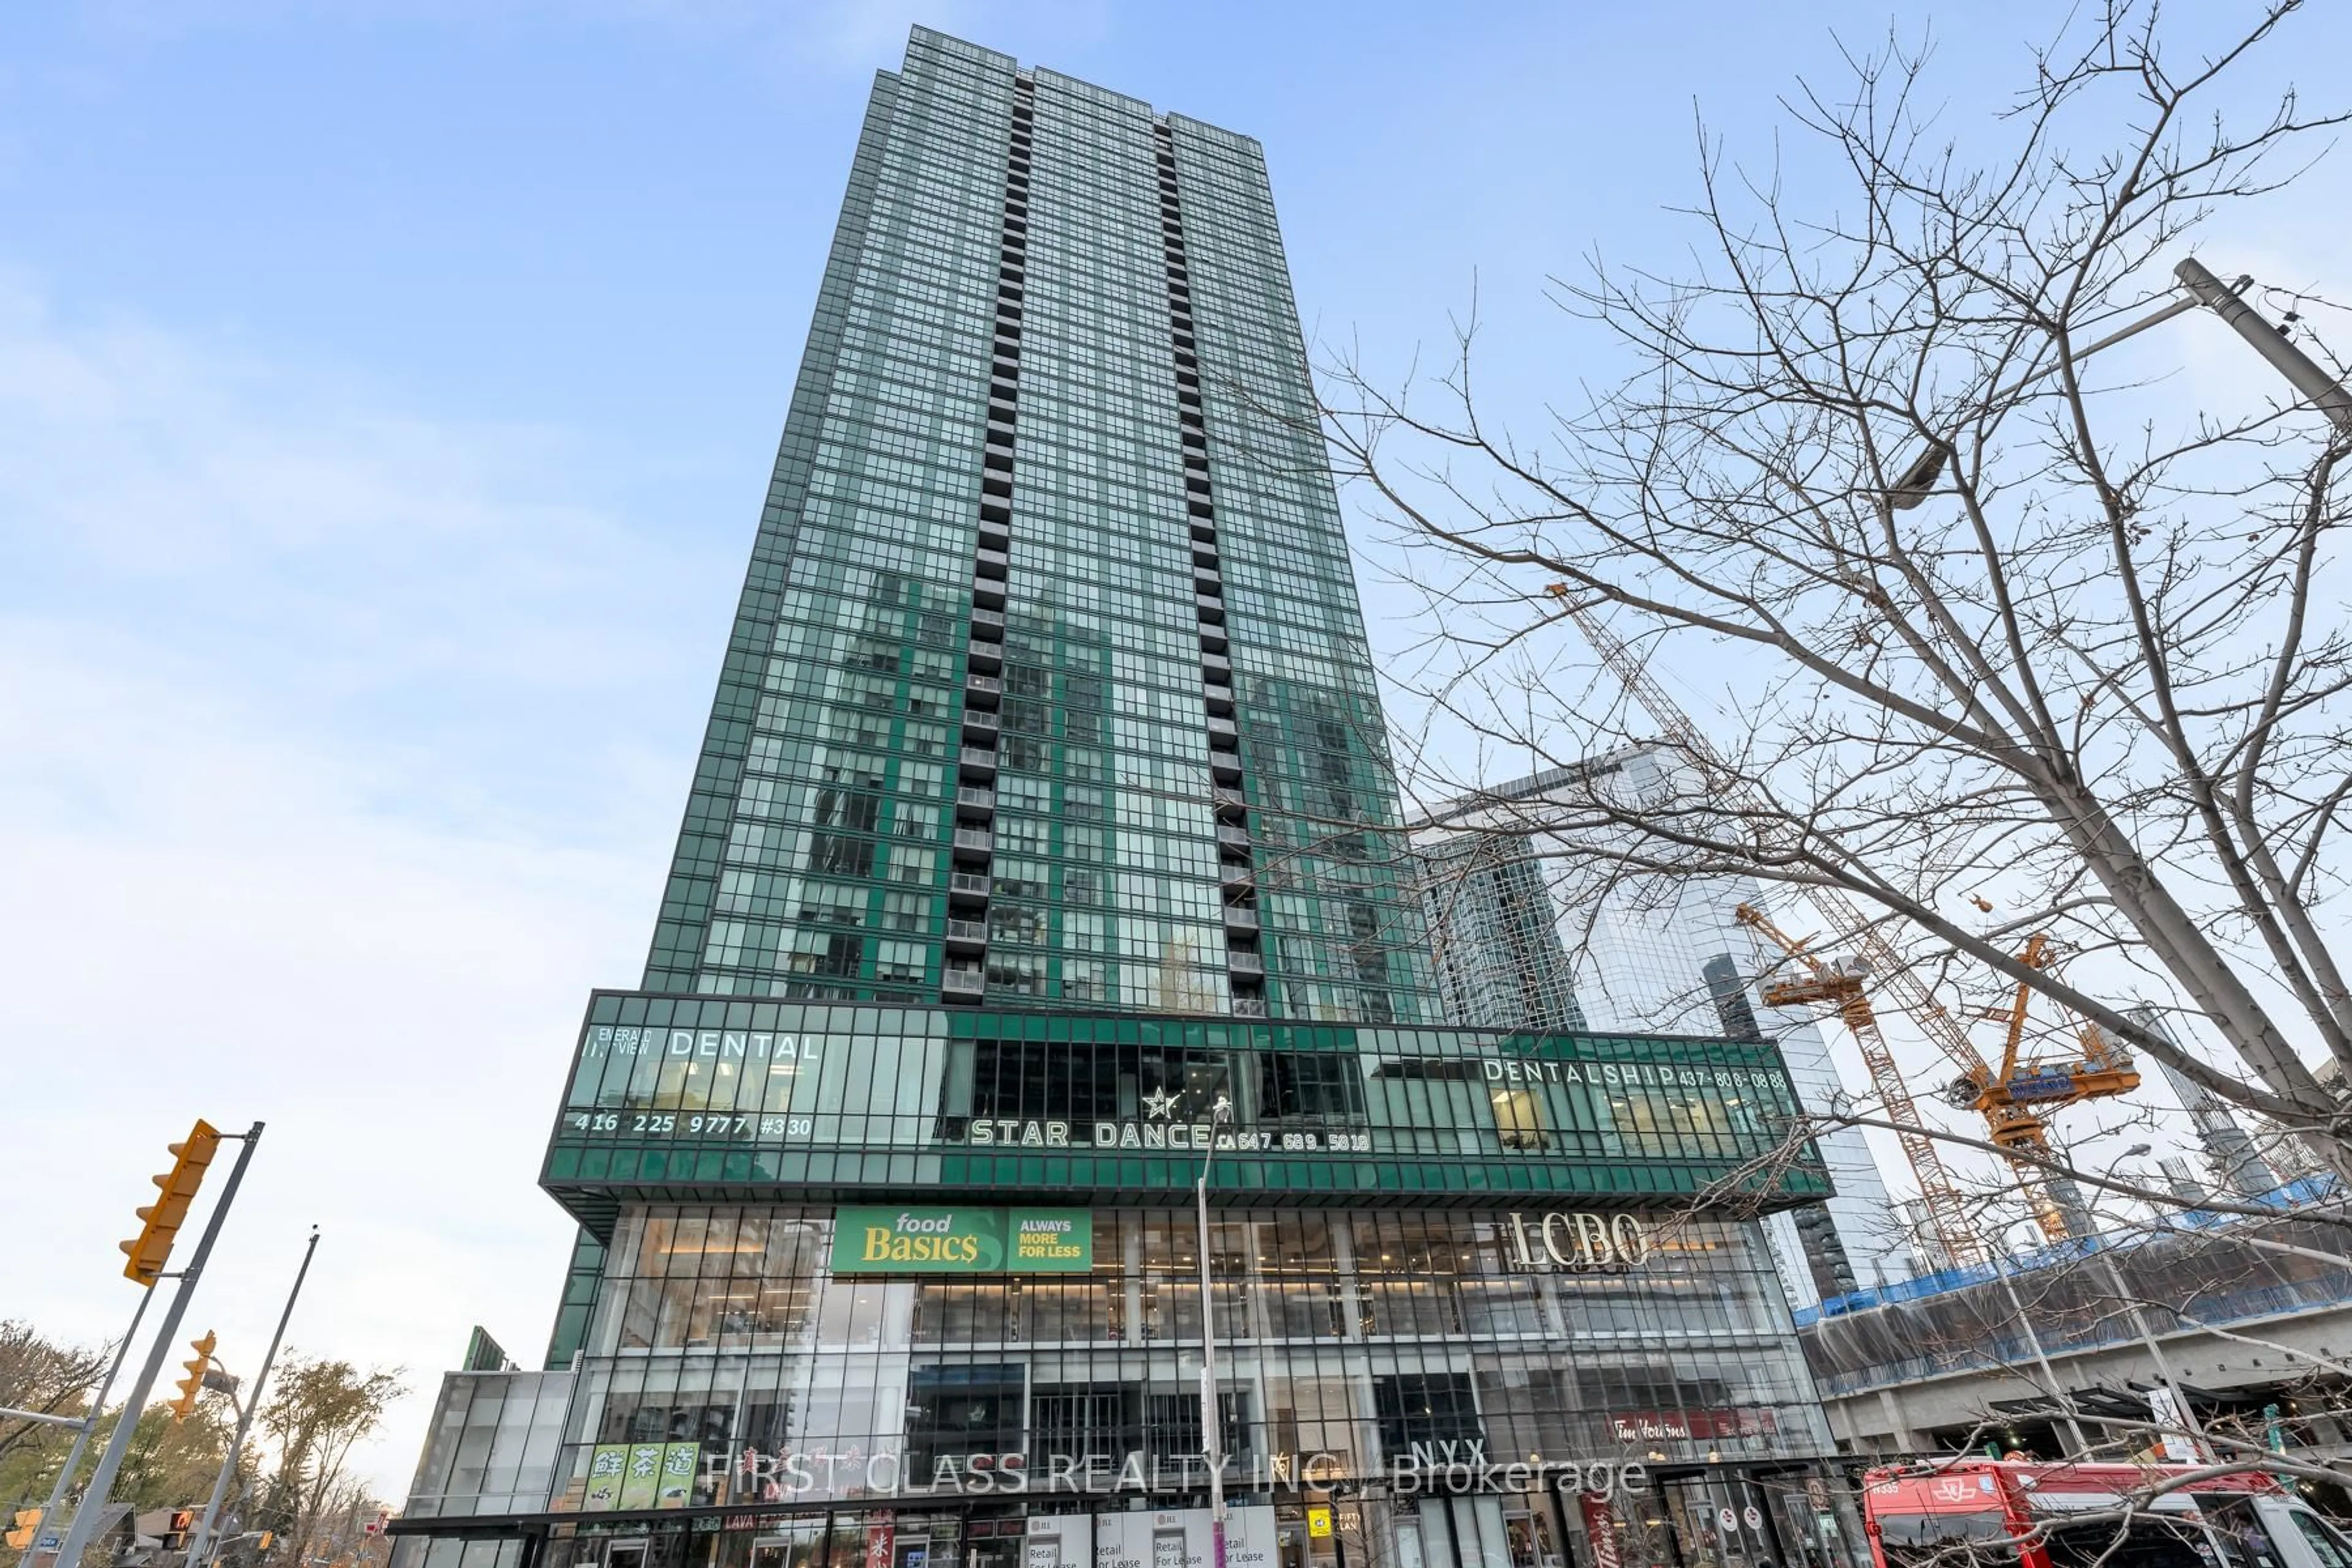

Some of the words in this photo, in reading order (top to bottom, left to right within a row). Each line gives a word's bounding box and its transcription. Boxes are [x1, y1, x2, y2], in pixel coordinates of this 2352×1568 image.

[672, 1032, 818, 1060] DENTAL
[1485, 1060, 1674, 1085] DENTALSHIP
[575, 1114, 617, 1131] 416
[633, 1115, 674, 1133] 225
[690, 1117, 746, 1133] 9777
[761, 1118, 811, 1135] #330
[971, 1120, 1068, 1146] STAR
[1238, 1133, 1271, 1150] 647
[1283, 1133, 1317, 1150] 689
[896, 1213, 952, 1233] food
[1020, 1220, 1071, 1232] ALWAYS
[1019, 1233, 1058, 1245] MORE
[1509, 1212, 1649, 1266] LCBO
[1019, 1246, 1045, 1258] FOR
[1048, 1246, 1081, 1258] LESS
[1411, 1438, 1488, 1465] NYX
[591, 1447, 694, 1479] 鮮茶道
[725, 1515, 753, 1529] LAVA
[1156, 1542, 1183, 1552] Retail
[1224, 1537, 1245, 1549] etail
[1030, 1548, 1057, 1559] Retail
[1224, 1554, 1234, 1562] or
[1236, 1552, 1264, 1562] Lease
[1112, 1559, 1140, 1568] Lease
[1156, 1556, 1171, 1567] For
